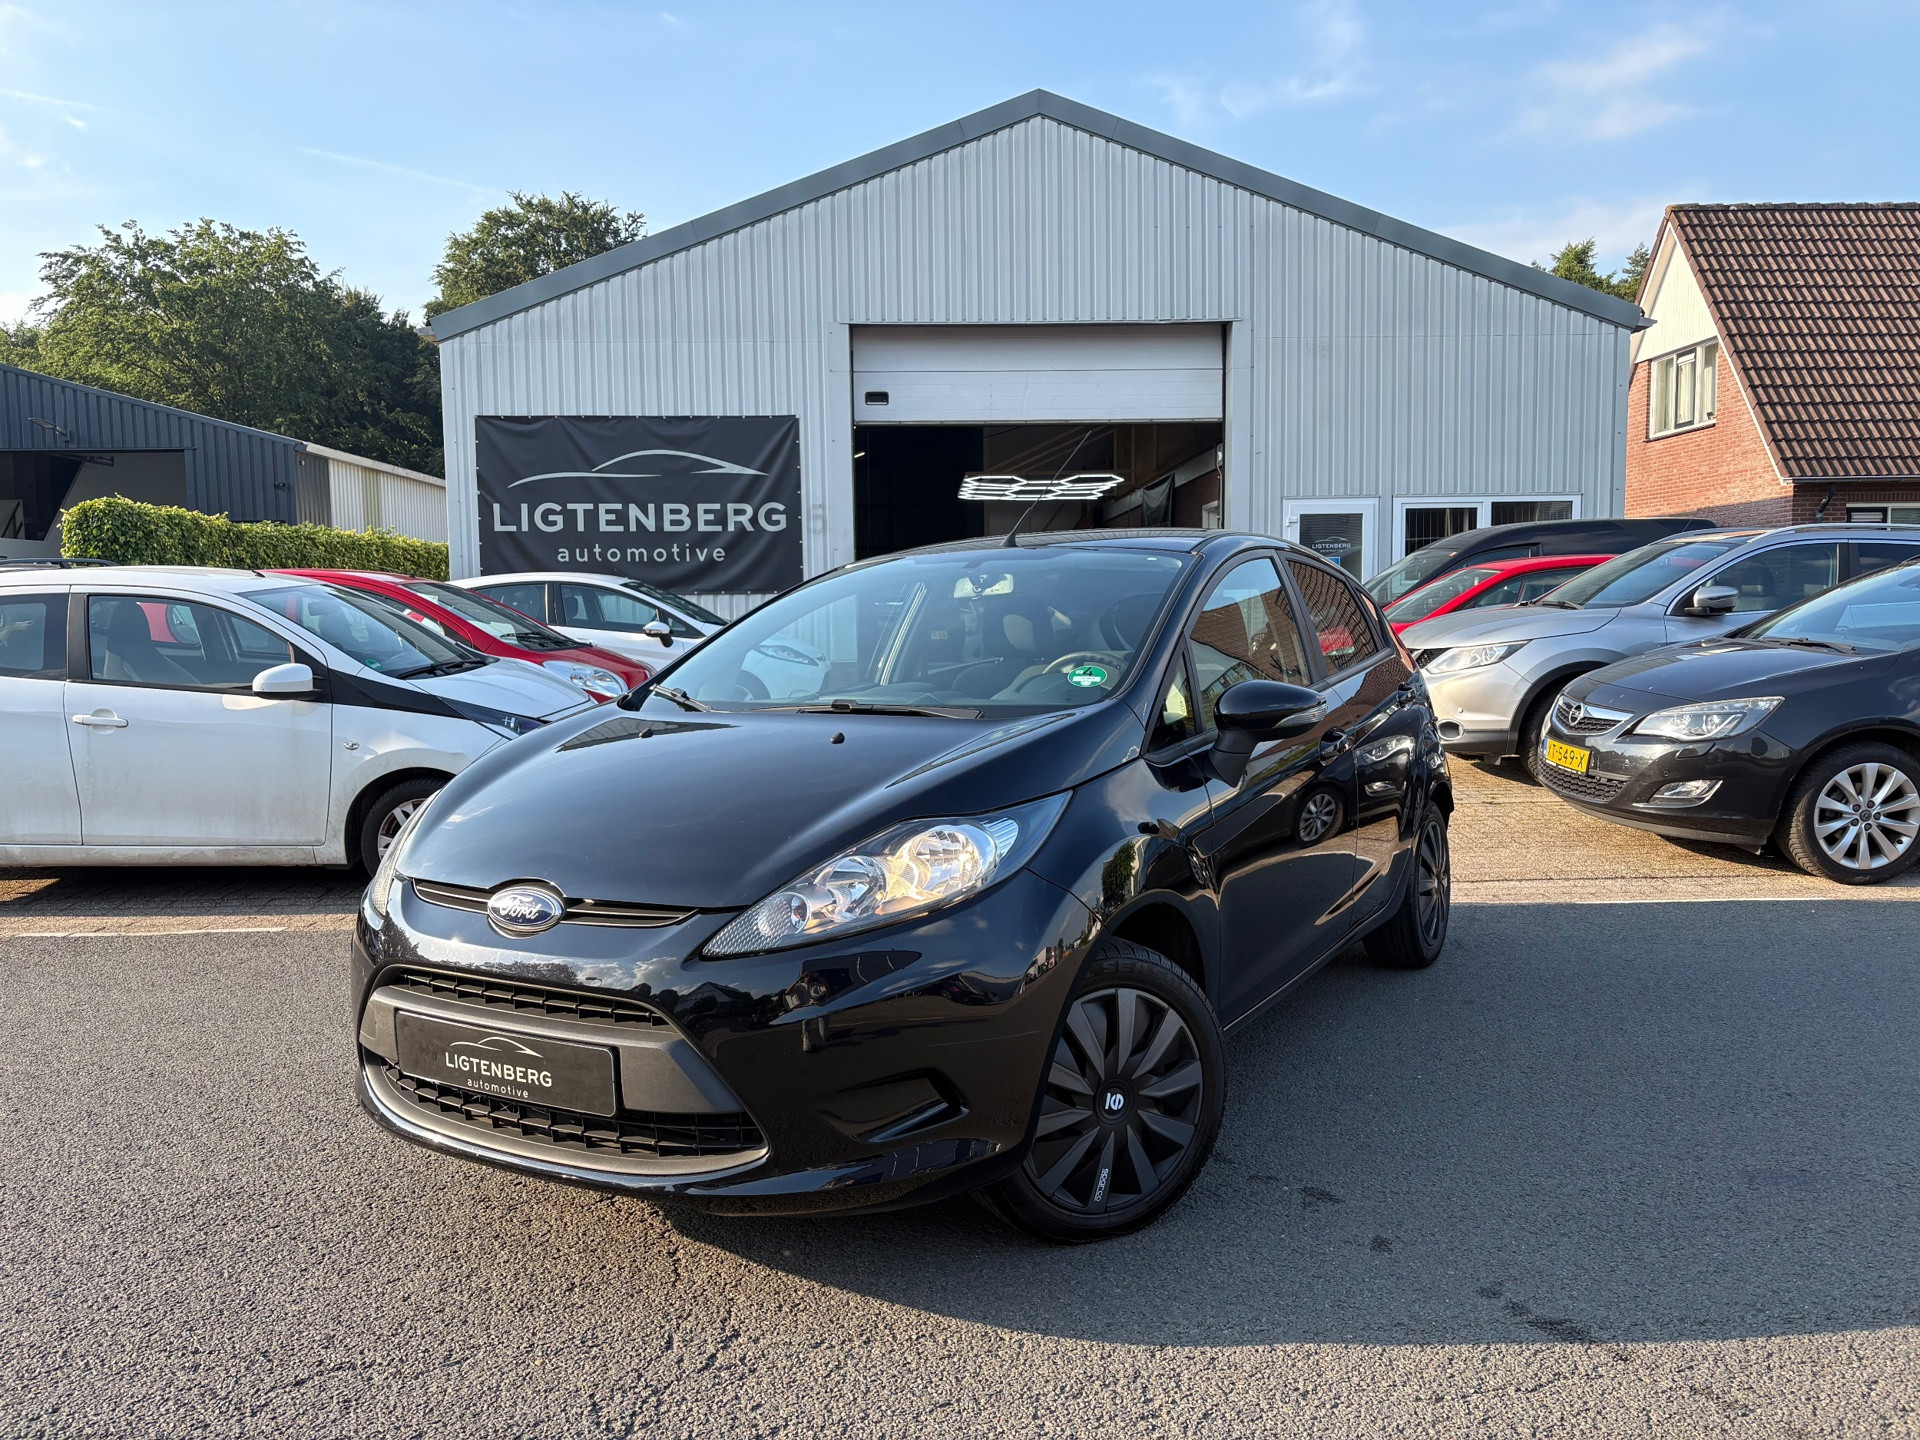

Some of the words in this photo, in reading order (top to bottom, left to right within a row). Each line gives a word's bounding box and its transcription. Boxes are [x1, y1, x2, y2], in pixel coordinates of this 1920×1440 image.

[493, 502, 787, 533] LIGTENBERG
[558, 544, 726, 562] automotive
[1548, 744, 1585, 769] XT-549-X
[499, 895, 542, 919] Ford
[445, 1052, 552, 1087] LIGTENBERG
[467, 1077, 529, 1098] automotive
